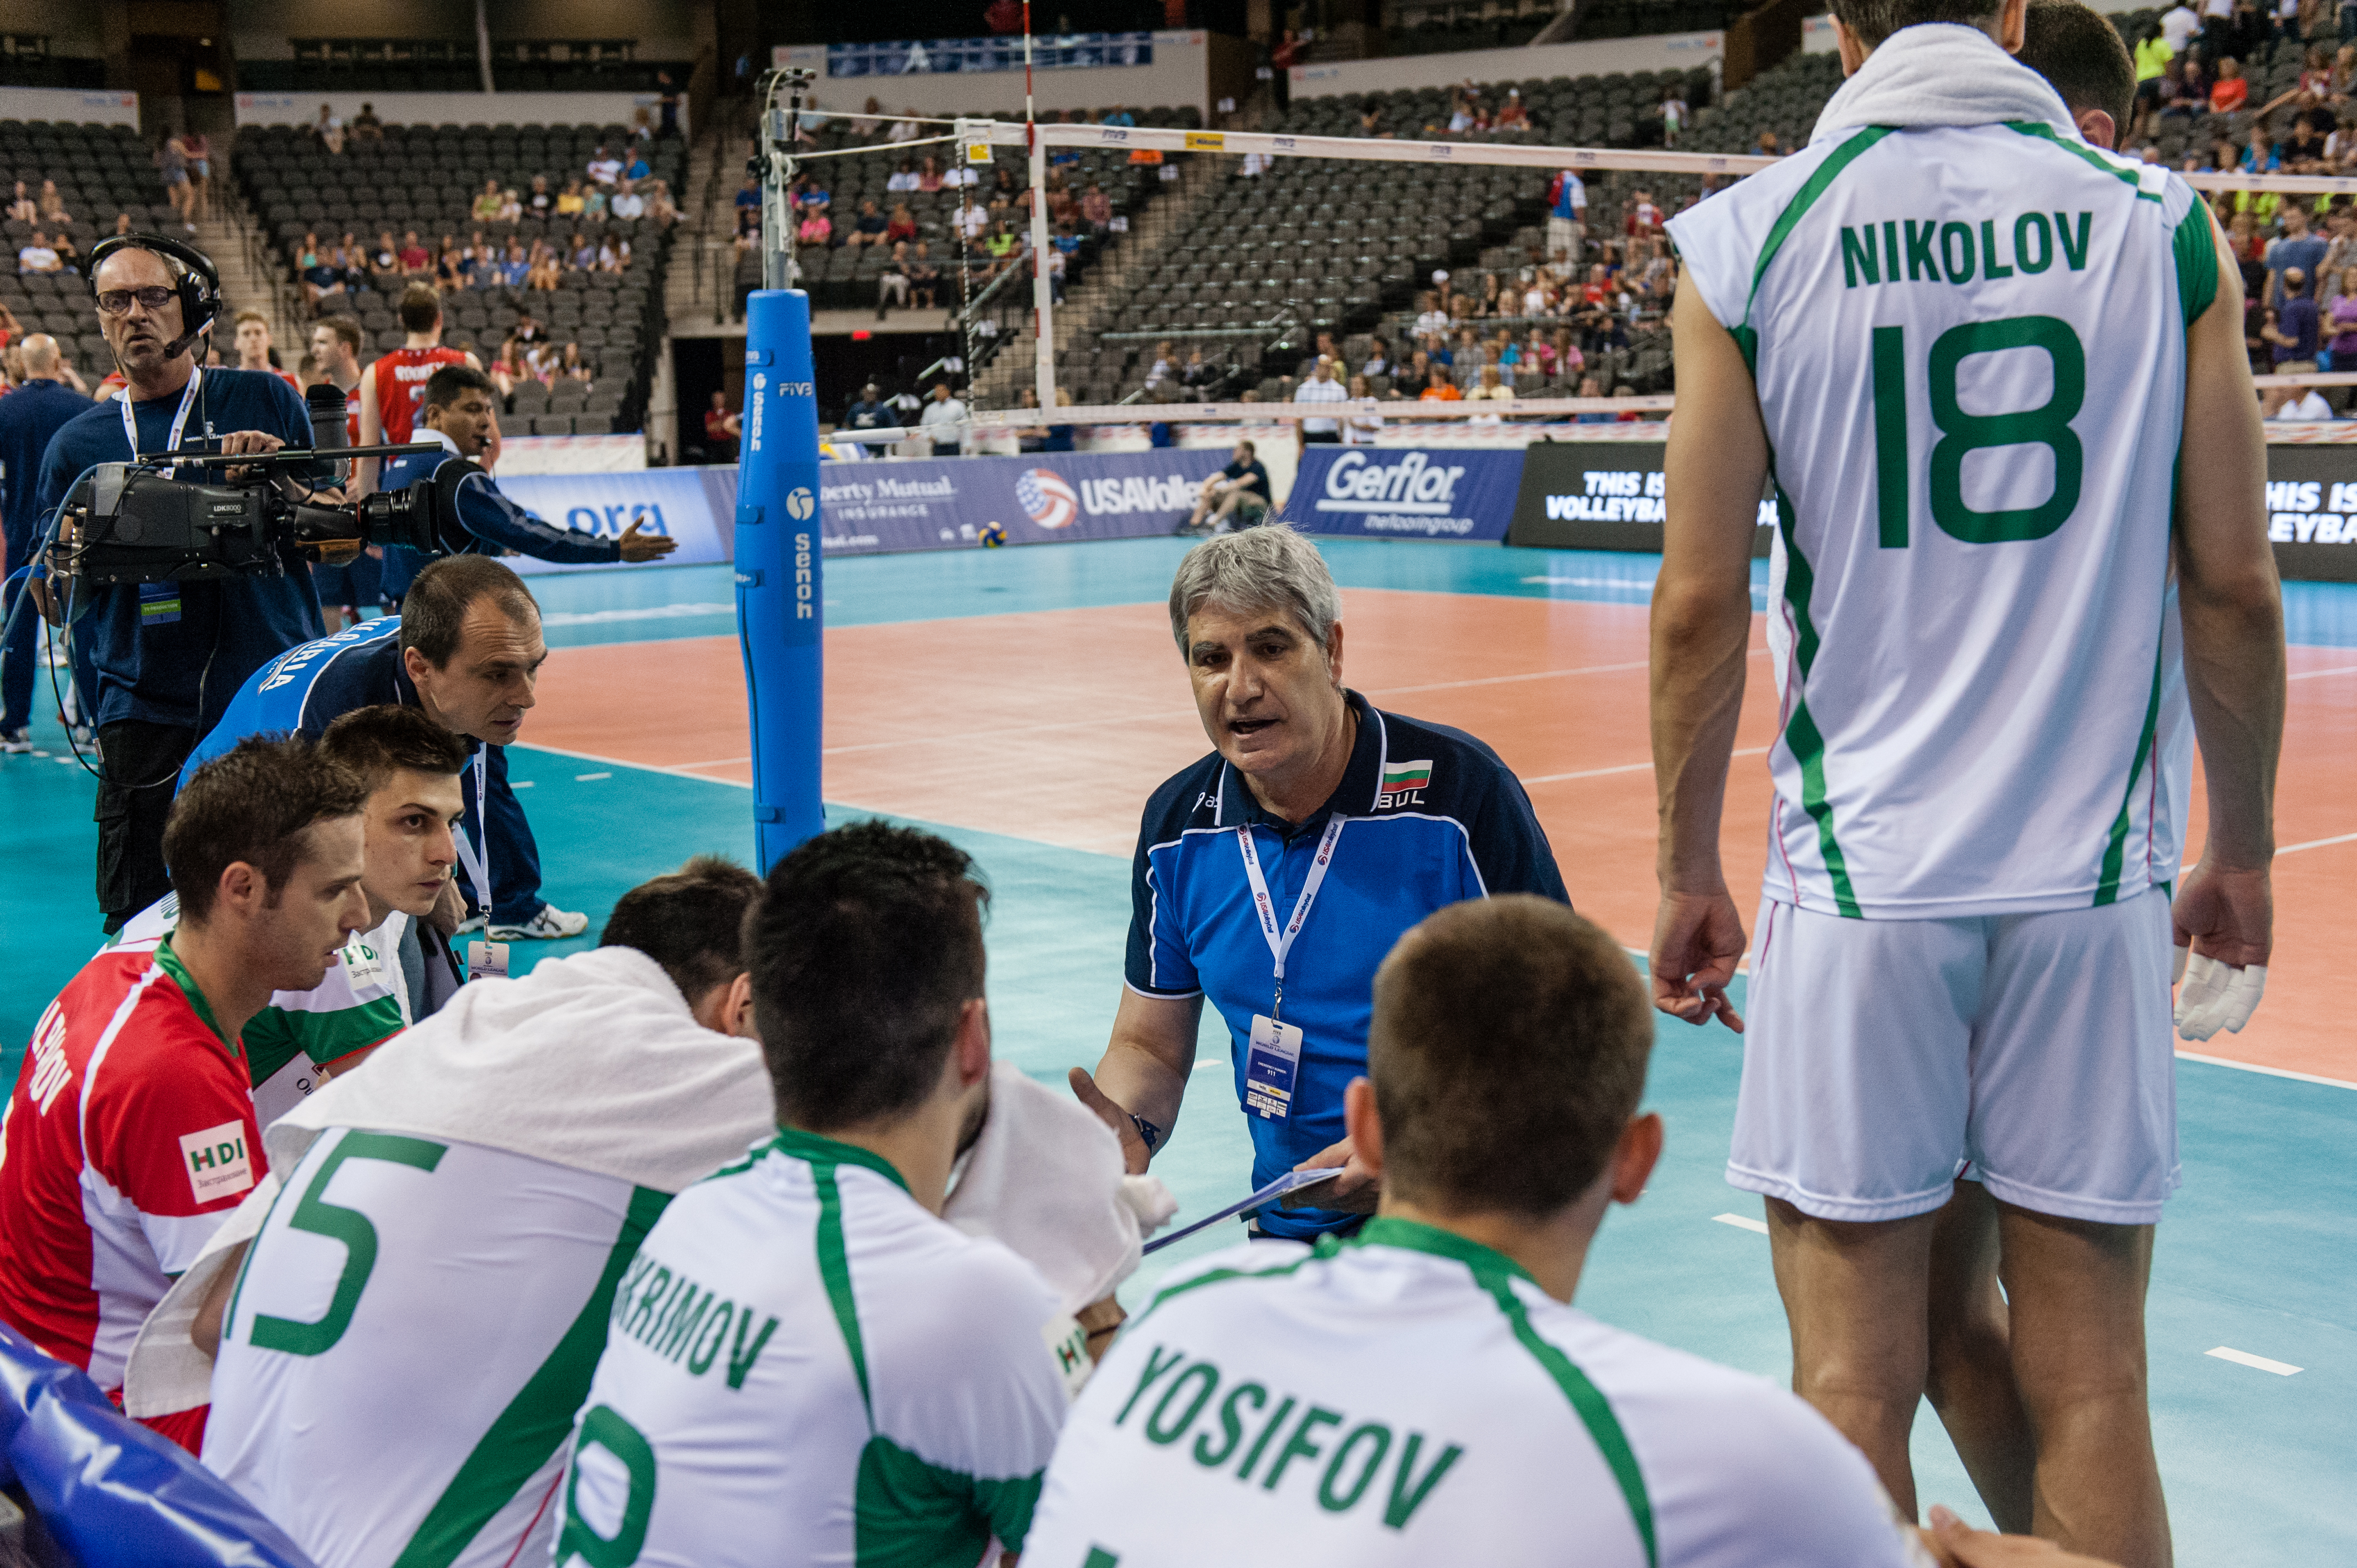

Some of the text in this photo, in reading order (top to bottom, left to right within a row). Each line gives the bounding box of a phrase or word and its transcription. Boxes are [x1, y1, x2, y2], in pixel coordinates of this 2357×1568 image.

[1840, 211, 2093, 288] NIKOLOV
[1872, 314, 2086, 549] 18
[1080, 474, 1203, 516] USAVolle
[1325, 450, 1466, 503] Gerflor
[1583, 471, 1642, 497] THIS
[2266, 481, 2322, 512] HIS
[1546, 494, 1666, 522] VOLLEYBA
[795, 533, 812, 620] senoh
[265, 616, 390, 691] ULGARIA
[1378, 790, 1425, 808] BUL
[297, 1078, 314, 1096] Ou
[190, 1138, 244, 1172] HDI
[611, 1250, 780, 1389] KRIMOV
[1114, 1342, 1465, 1530] YOSIFOV
